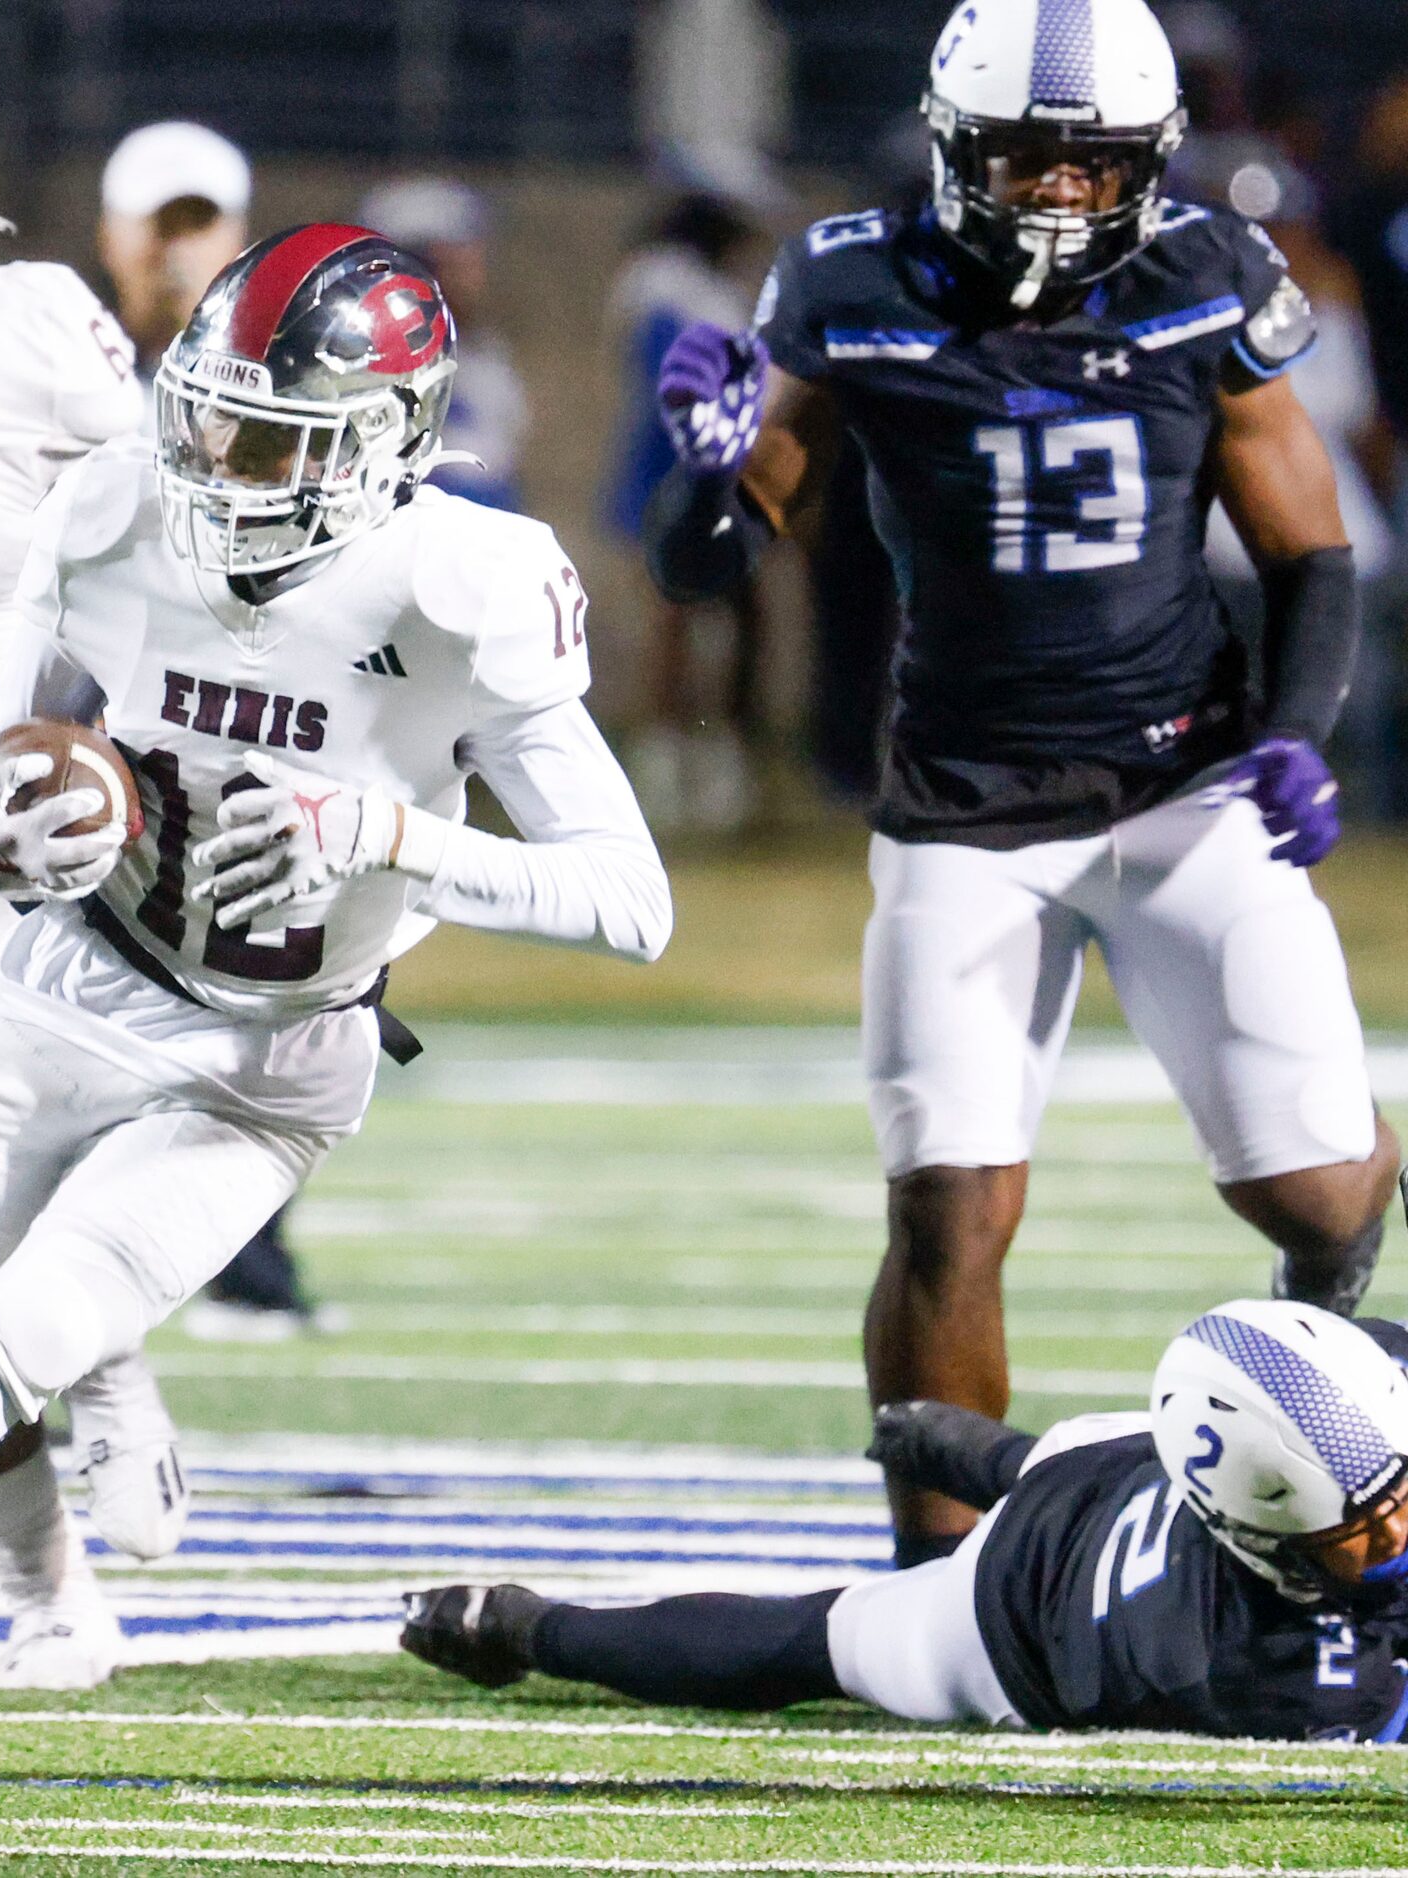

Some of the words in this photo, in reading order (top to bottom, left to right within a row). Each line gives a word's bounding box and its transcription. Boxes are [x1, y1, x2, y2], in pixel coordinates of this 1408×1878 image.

[203, 359, 261, 389] LIONS
[972, 412, 1149, 574] 13
[161, 669, 328, 752] ENNIS
[1184, 1424, 1224, 1498] 2
[1092, 1477, 1184, 1625] 2
[1315, 1614, 1358, 1688] 2
